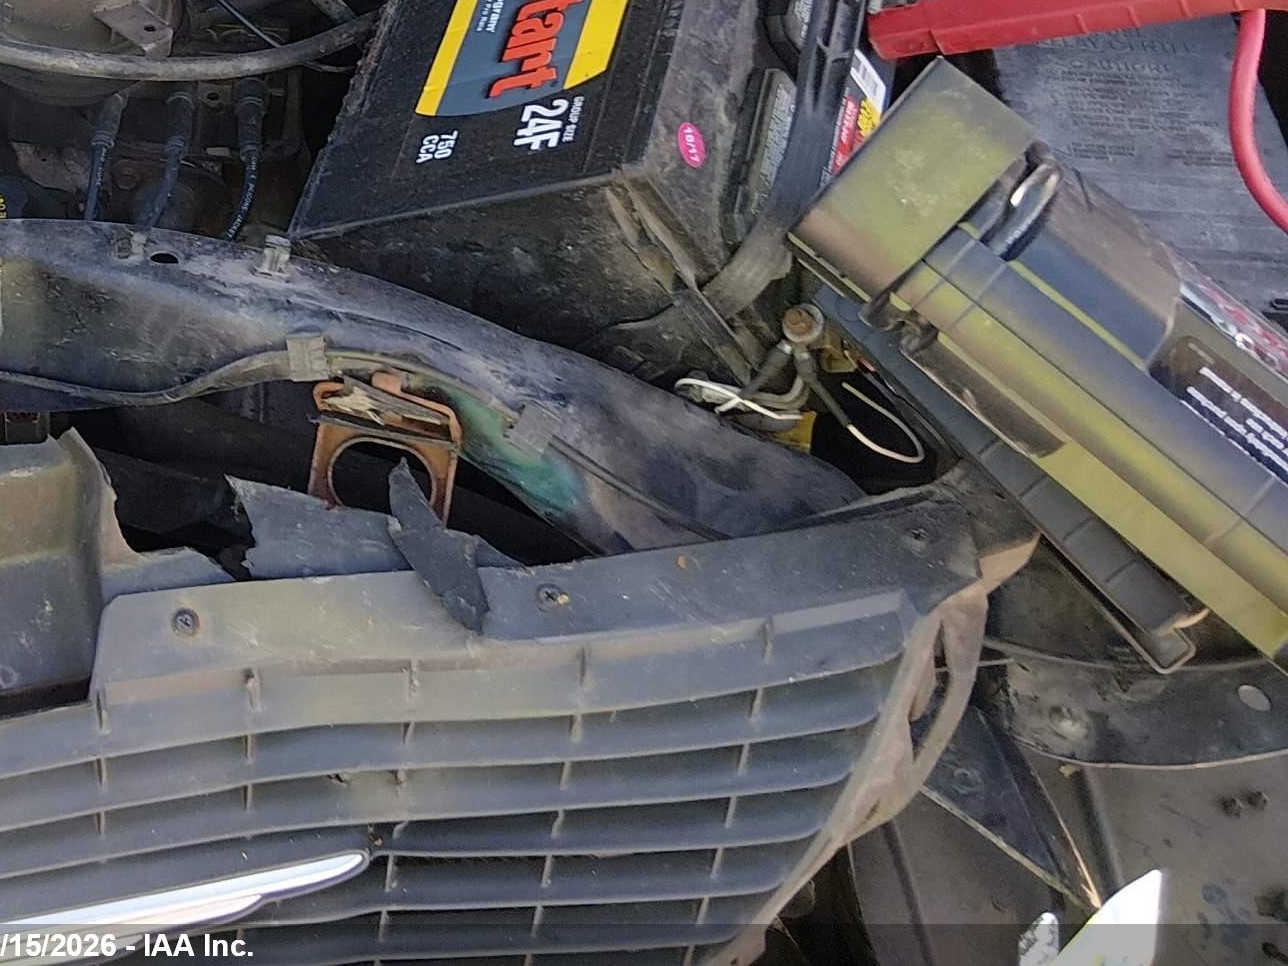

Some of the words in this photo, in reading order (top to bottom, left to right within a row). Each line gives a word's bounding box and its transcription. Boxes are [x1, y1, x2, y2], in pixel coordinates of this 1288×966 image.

[569, 96, 584, 123] GROUP
[513, 99, 569, 150] 24F
[563, 124, 577, 142] SIZE
[416, 135, 440, 164] CCA
[434, 130, 458, 160] 750
